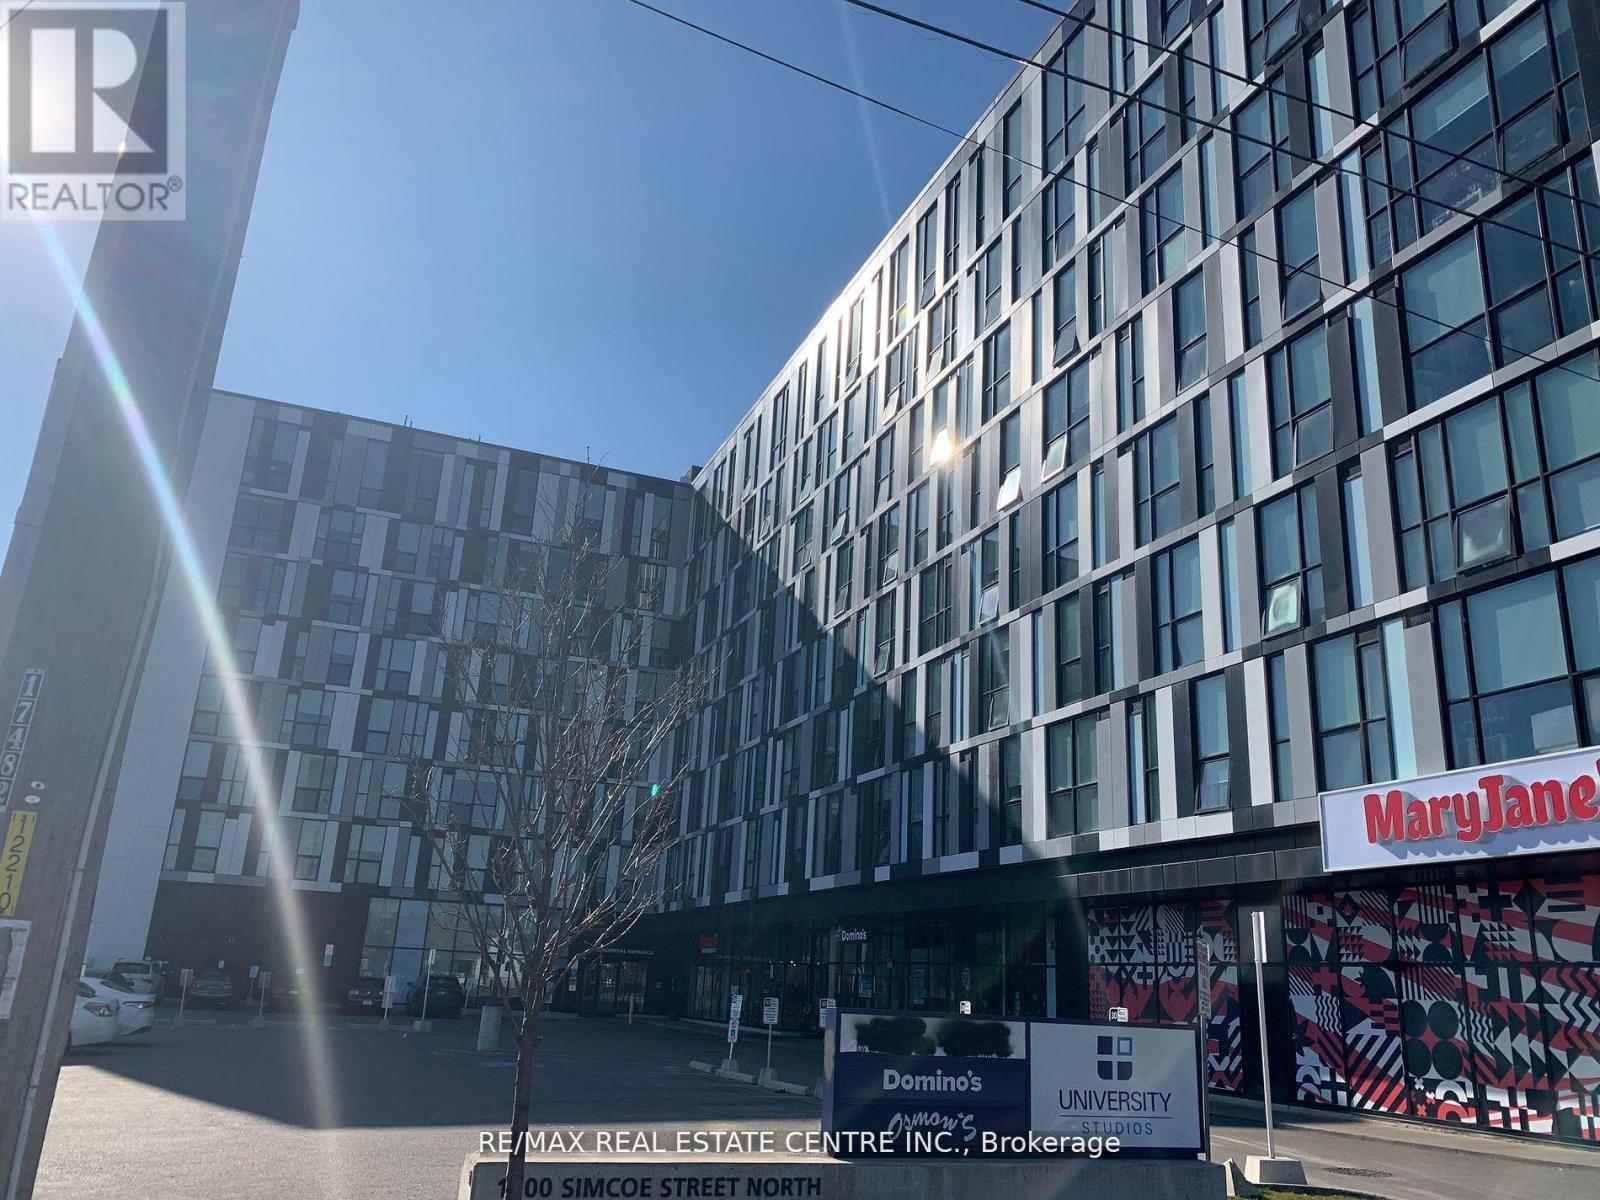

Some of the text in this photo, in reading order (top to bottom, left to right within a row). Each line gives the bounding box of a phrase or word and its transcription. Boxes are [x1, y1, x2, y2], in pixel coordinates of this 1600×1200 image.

[841, 928, 867, 941] Domino's
[882, 1069, 983, 1092] Domino's
[1058, 1089, 1172, 1112] UNIVERSITY
[1081, 1121, 1153, 1135] STUDIOS
[497, 1176, 822, 1199] 100 SIMCOE STREET NORTH
